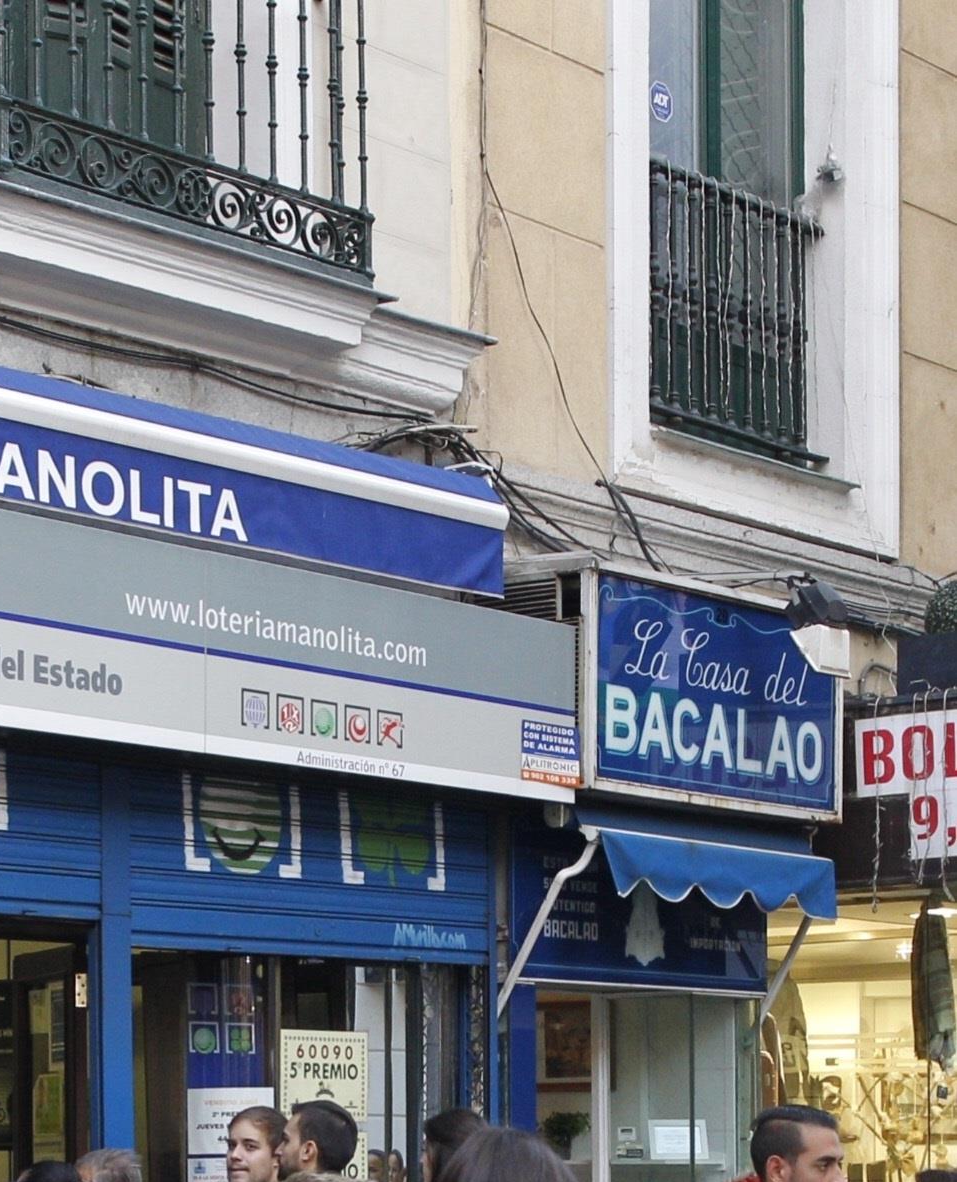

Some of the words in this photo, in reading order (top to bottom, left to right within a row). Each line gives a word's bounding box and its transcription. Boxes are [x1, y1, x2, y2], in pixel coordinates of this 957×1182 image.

[125, 591, 427, 667] www.loteriamanolita.com
[624, 618, 669, 681] La
[680, 628, 751, 695] Casa
[764, 652, 809, 706] del
[33, 654, 123, 696] Estado
[523, 731, 540, 740] CON
[541, 734, 575, 746] SISTEMA
[524, 722, 574, 737] PROTEGIDO
[604, 683, 825, 786] BACALAO
[523, 740, 535, 749] DE
[537, 743, 576, 755] ALARMA
[297, 751, 376, 774] Administración
[392, 764, 405, 777] 67
[523, 756, 577, 773] APLITRONIC
[543, 919, 599, 941] BACALAO
[296, 1044, 354, 1061] 60090
[303, 1063, 359, 1080] PREMIO
